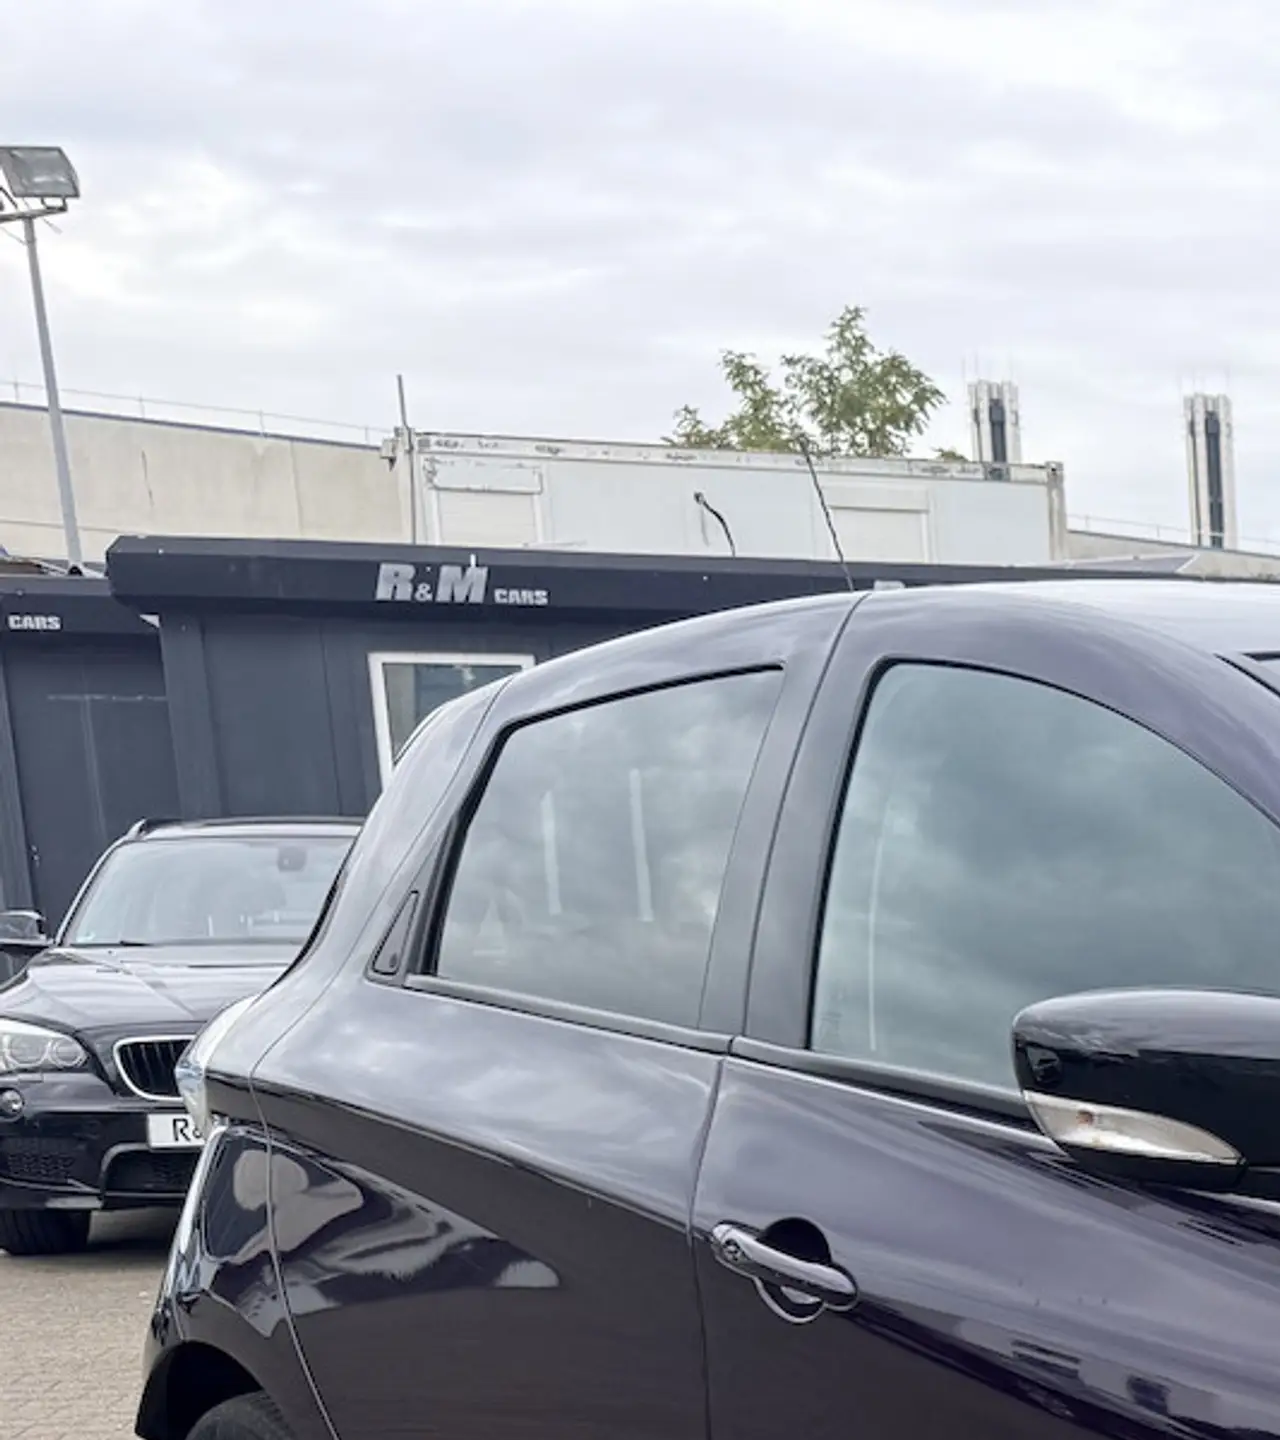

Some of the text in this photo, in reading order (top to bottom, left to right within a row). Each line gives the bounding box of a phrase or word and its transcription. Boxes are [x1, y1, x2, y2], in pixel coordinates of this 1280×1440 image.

[375, 562, 549, 605] R&M CARS
[8, 614, 61, 630] CARS
